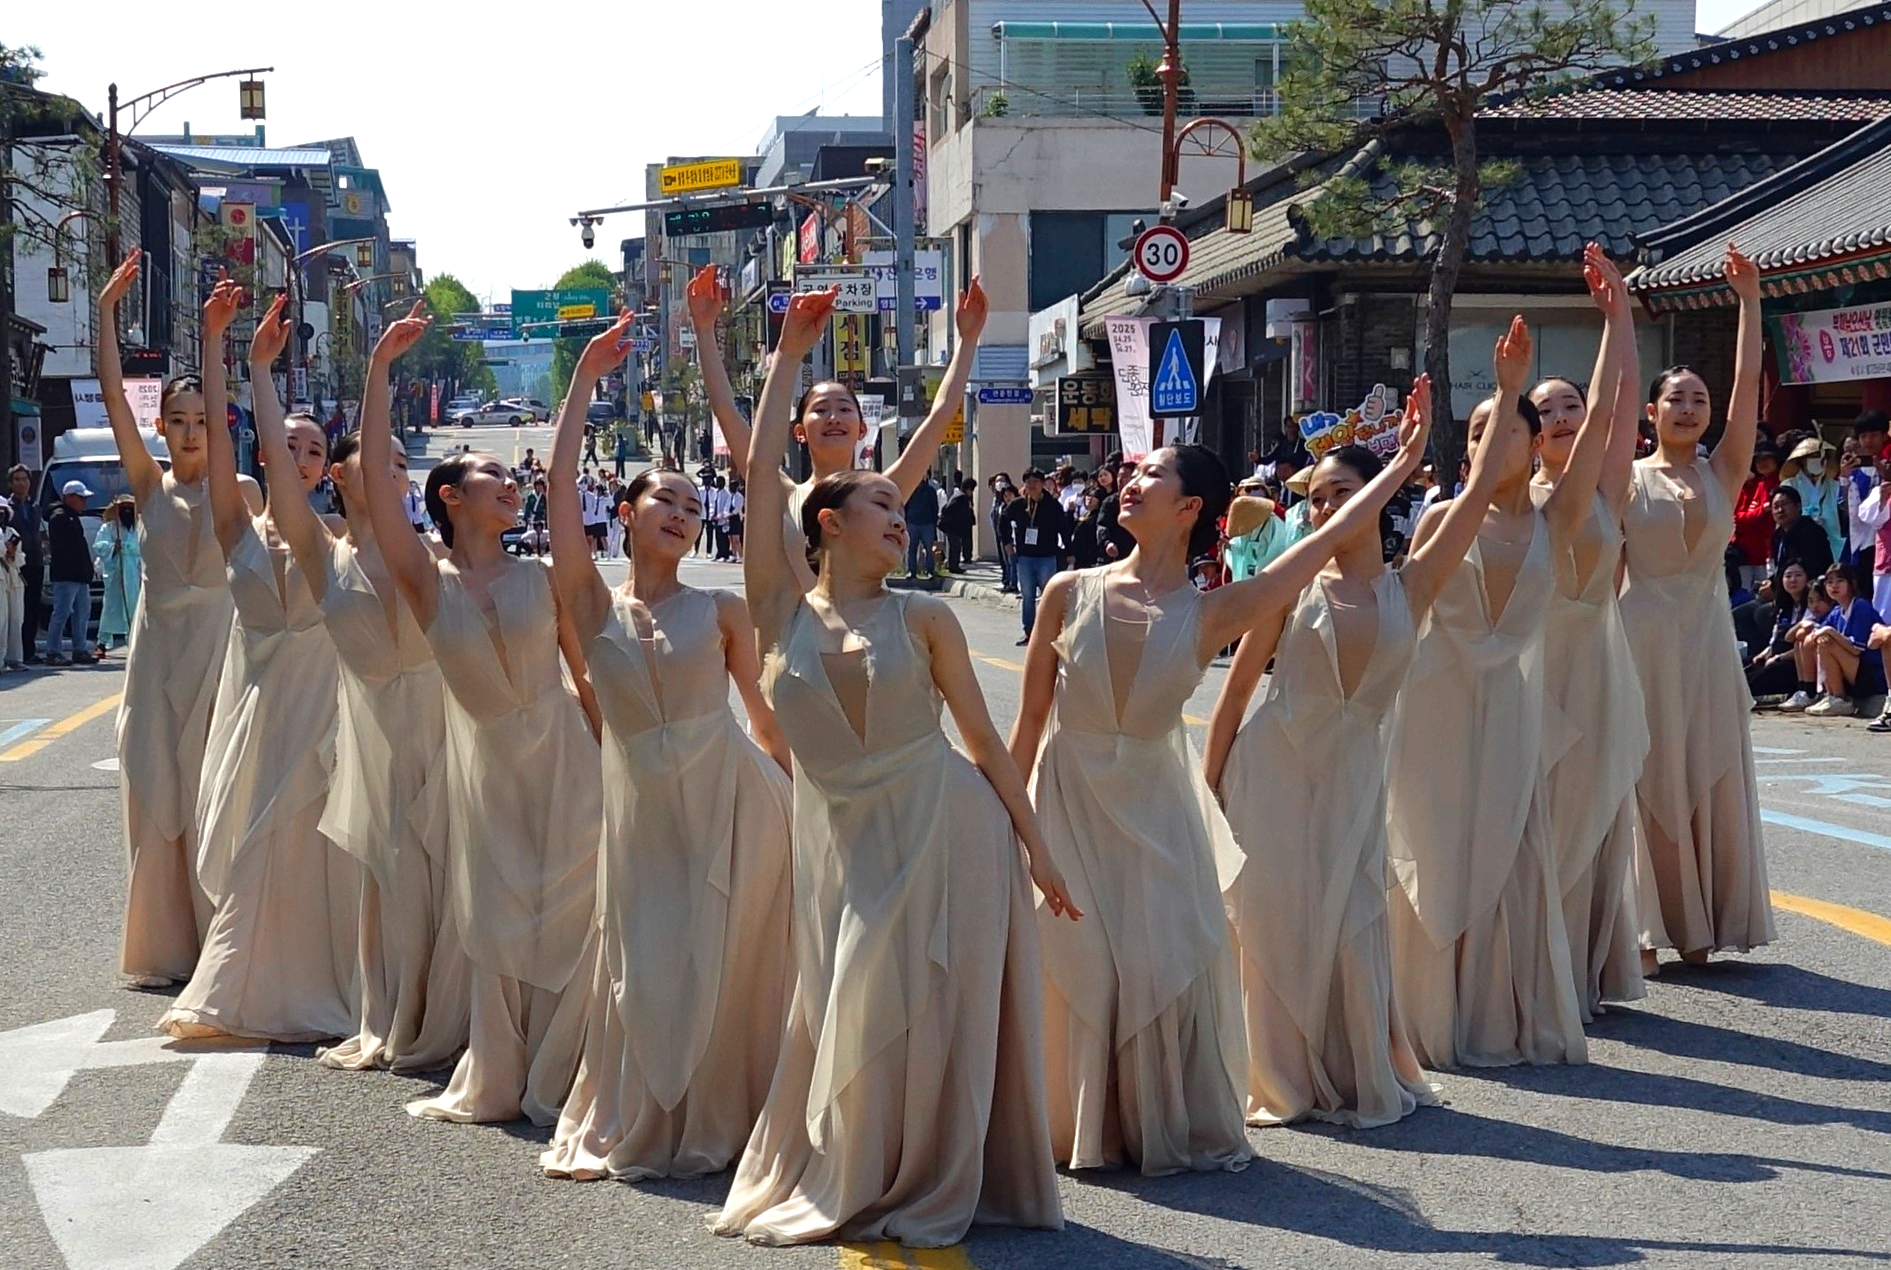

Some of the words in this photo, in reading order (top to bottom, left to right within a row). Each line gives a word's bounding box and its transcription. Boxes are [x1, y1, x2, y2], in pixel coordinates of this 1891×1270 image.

[1147, 242, 1178, 266] 30
[887, 267, 937, 281] 신은행
[836, 299, 873, 308] Parking
[1112, 324, 1136, 334] 2025
[1839, 336, 1871, 359] 제21회
[1871, 330, 1891, 355] 군민
[1159, 392, 1191, 407] 횡단보도
